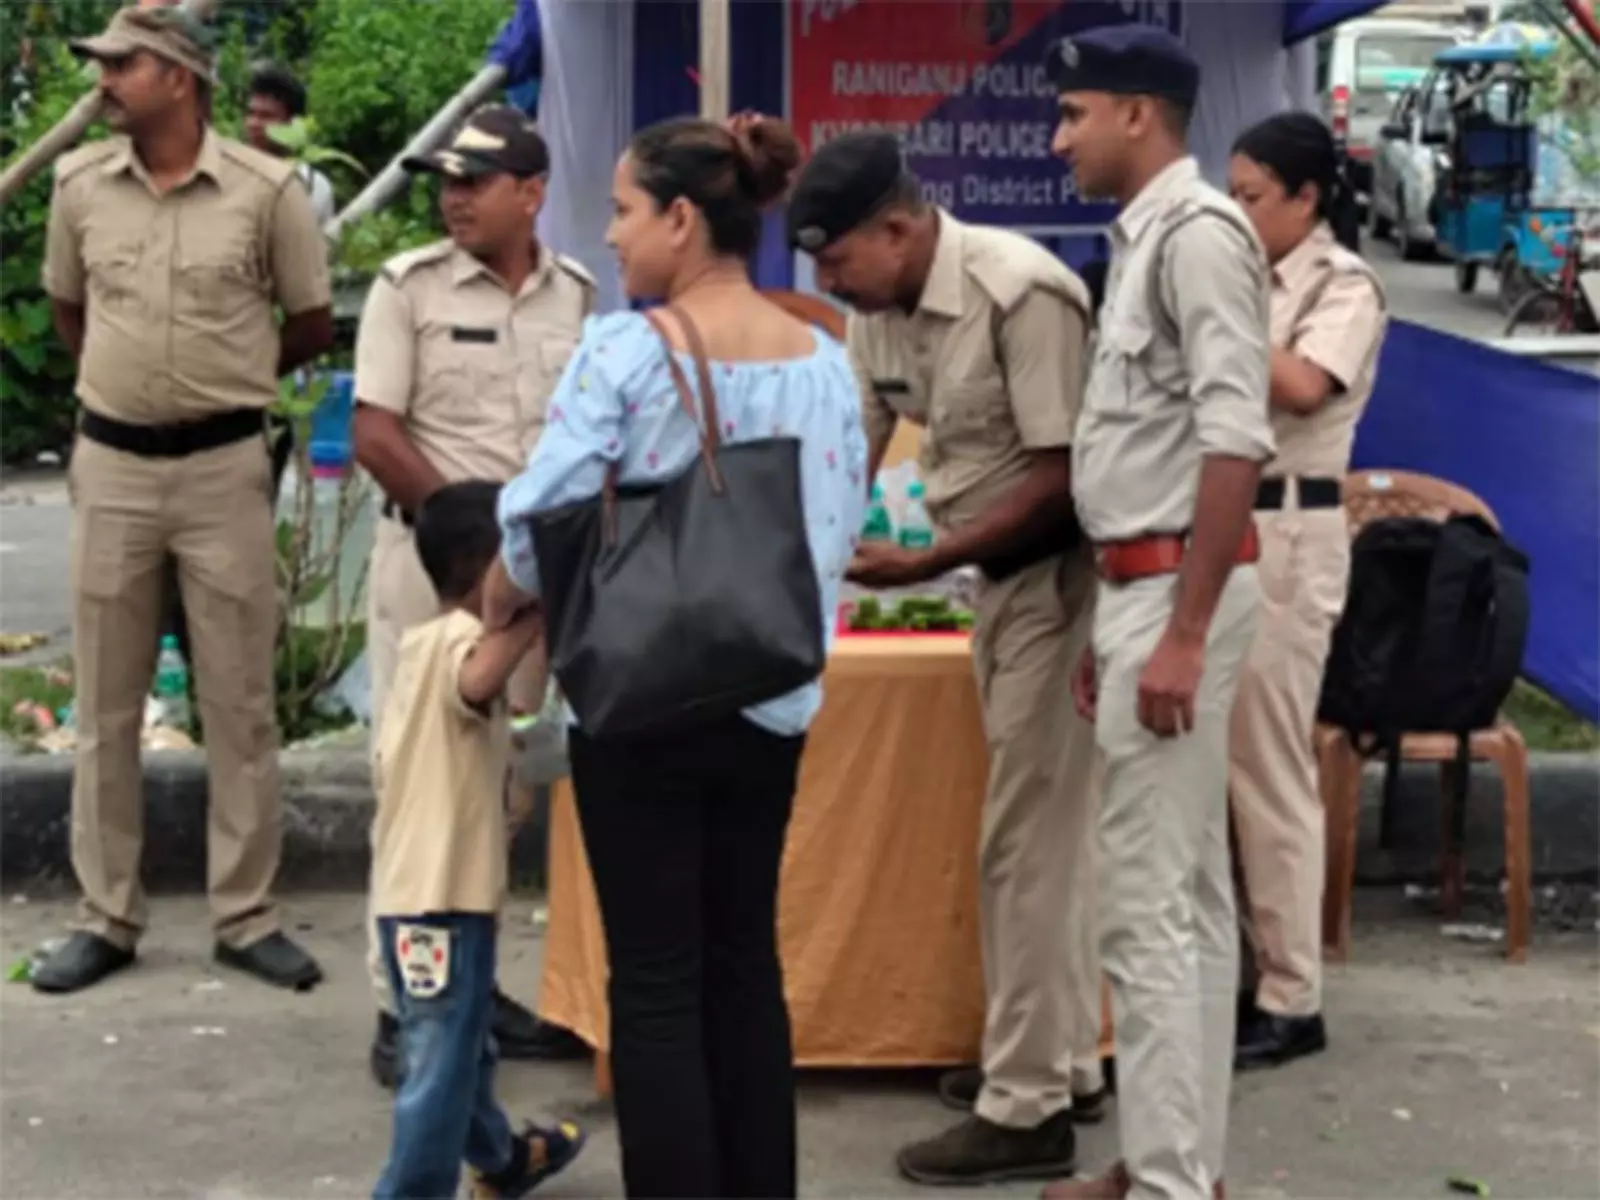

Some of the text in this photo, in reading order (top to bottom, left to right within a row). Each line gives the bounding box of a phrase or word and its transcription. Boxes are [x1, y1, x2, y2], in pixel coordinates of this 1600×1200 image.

[832, 62, 968, 97] RANIGANJ
[809, 120, 1048, 158] KBARI POLICE
[962, 173, 1054, 206] District
